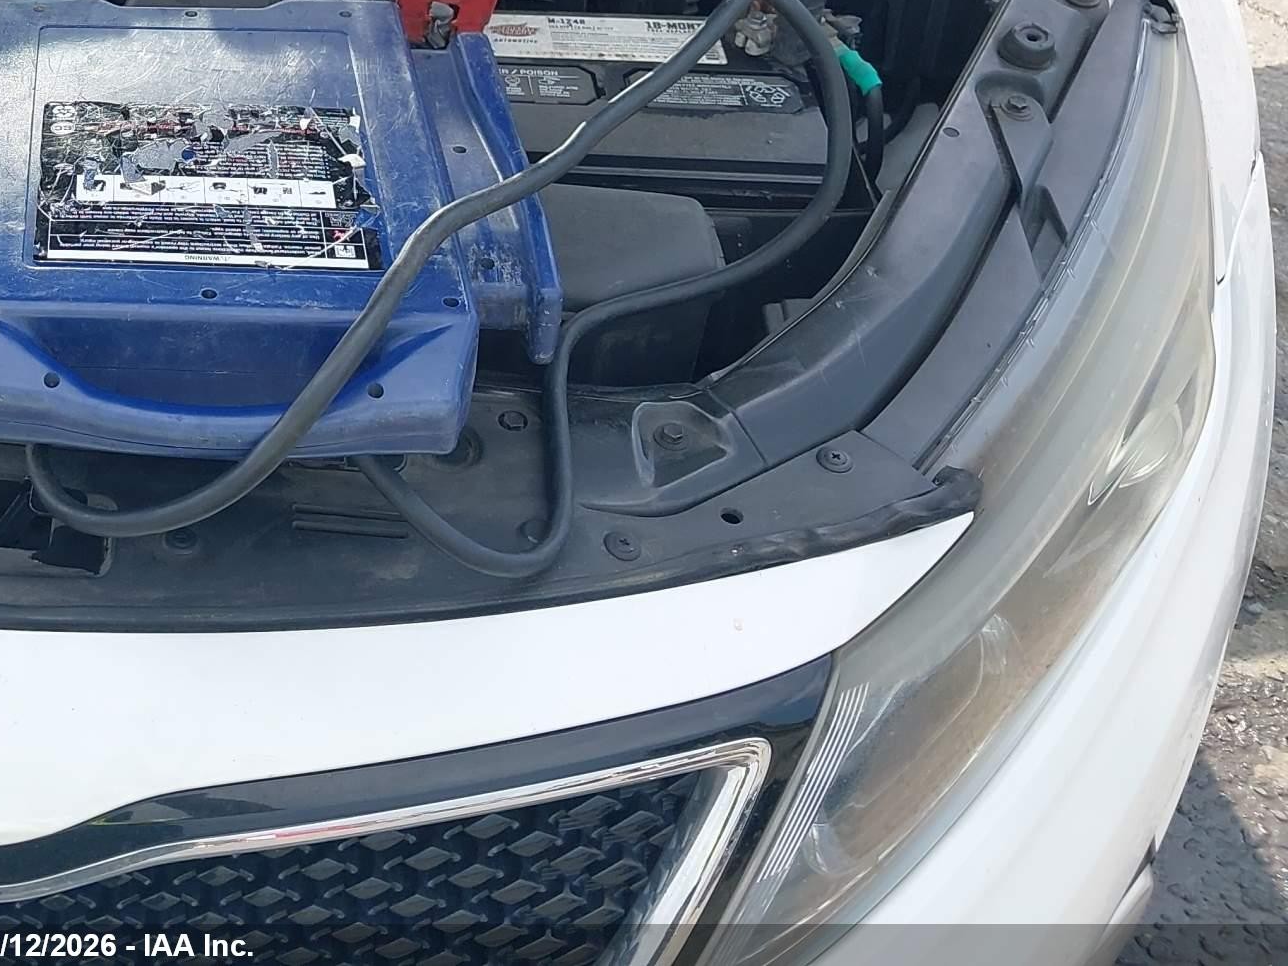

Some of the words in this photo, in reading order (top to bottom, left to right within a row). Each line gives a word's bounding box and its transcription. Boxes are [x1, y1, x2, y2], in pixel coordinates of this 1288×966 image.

[645, 21, 701, 30] 18-MONT
[520, 68, 559, 76] POISON
[185, 254, 221, 262] WARNING
